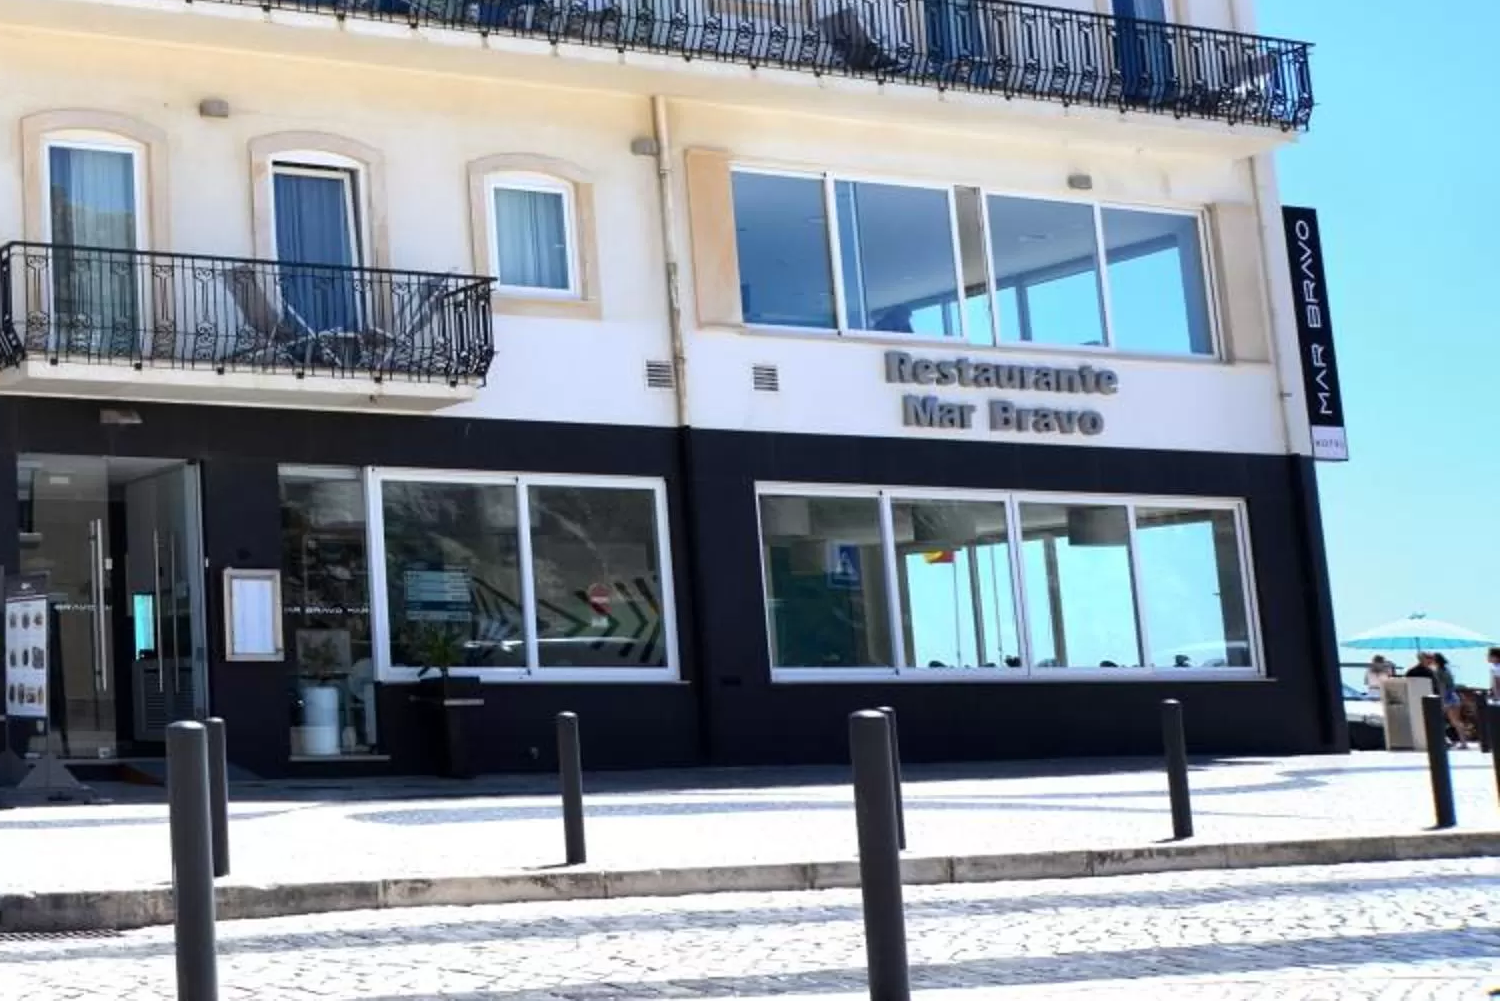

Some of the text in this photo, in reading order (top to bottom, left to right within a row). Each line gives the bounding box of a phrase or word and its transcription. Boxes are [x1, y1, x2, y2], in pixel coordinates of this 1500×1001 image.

[1295, 219, 1332, 414] MAR BRAVO
[884, 350, 1119, 395] Restaurante
[902, 394, 1105, 435] Mar Bravo
